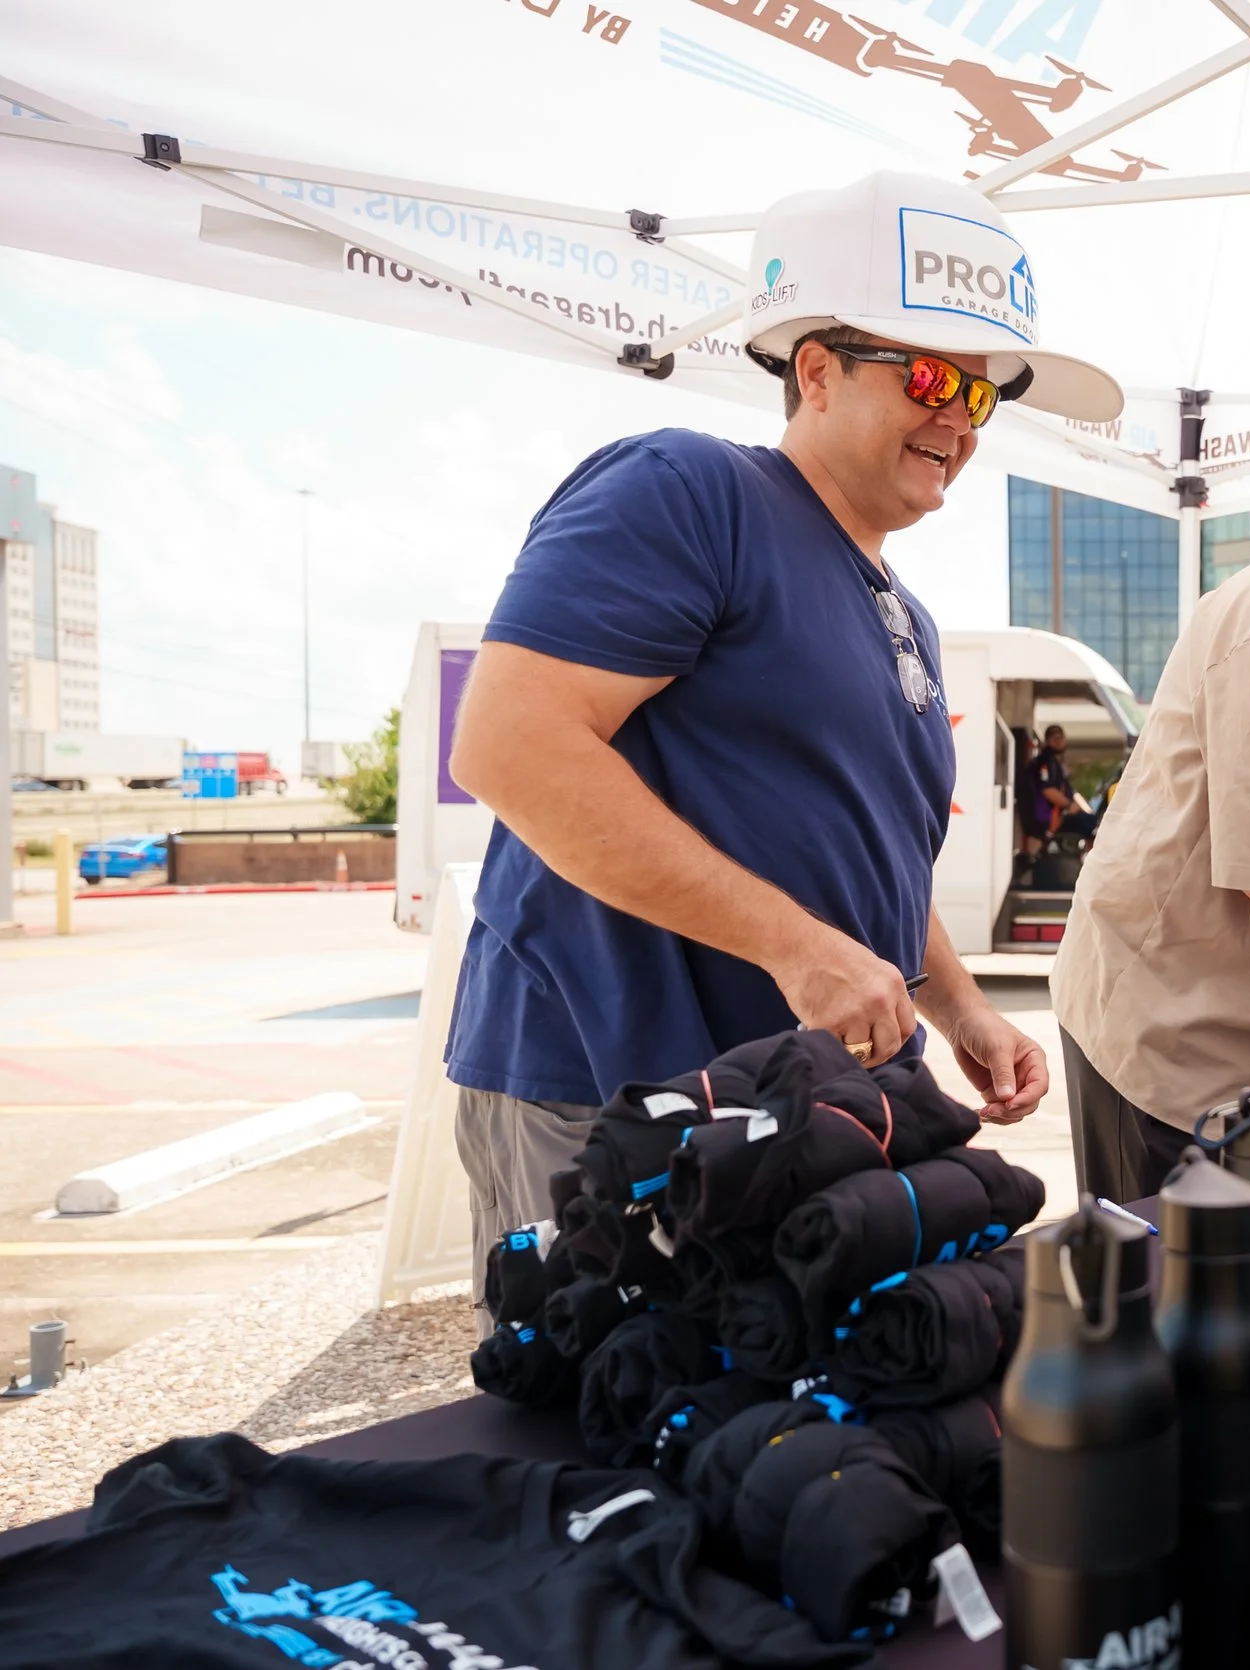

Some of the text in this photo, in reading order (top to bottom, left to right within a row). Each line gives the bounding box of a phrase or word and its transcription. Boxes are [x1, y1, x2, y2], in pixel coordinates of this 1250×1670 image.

[772, 283, 796, 303] LIFT
[941, 295, 1009, 322] GARAGE
[877, 351, 897, 359] KUSH
